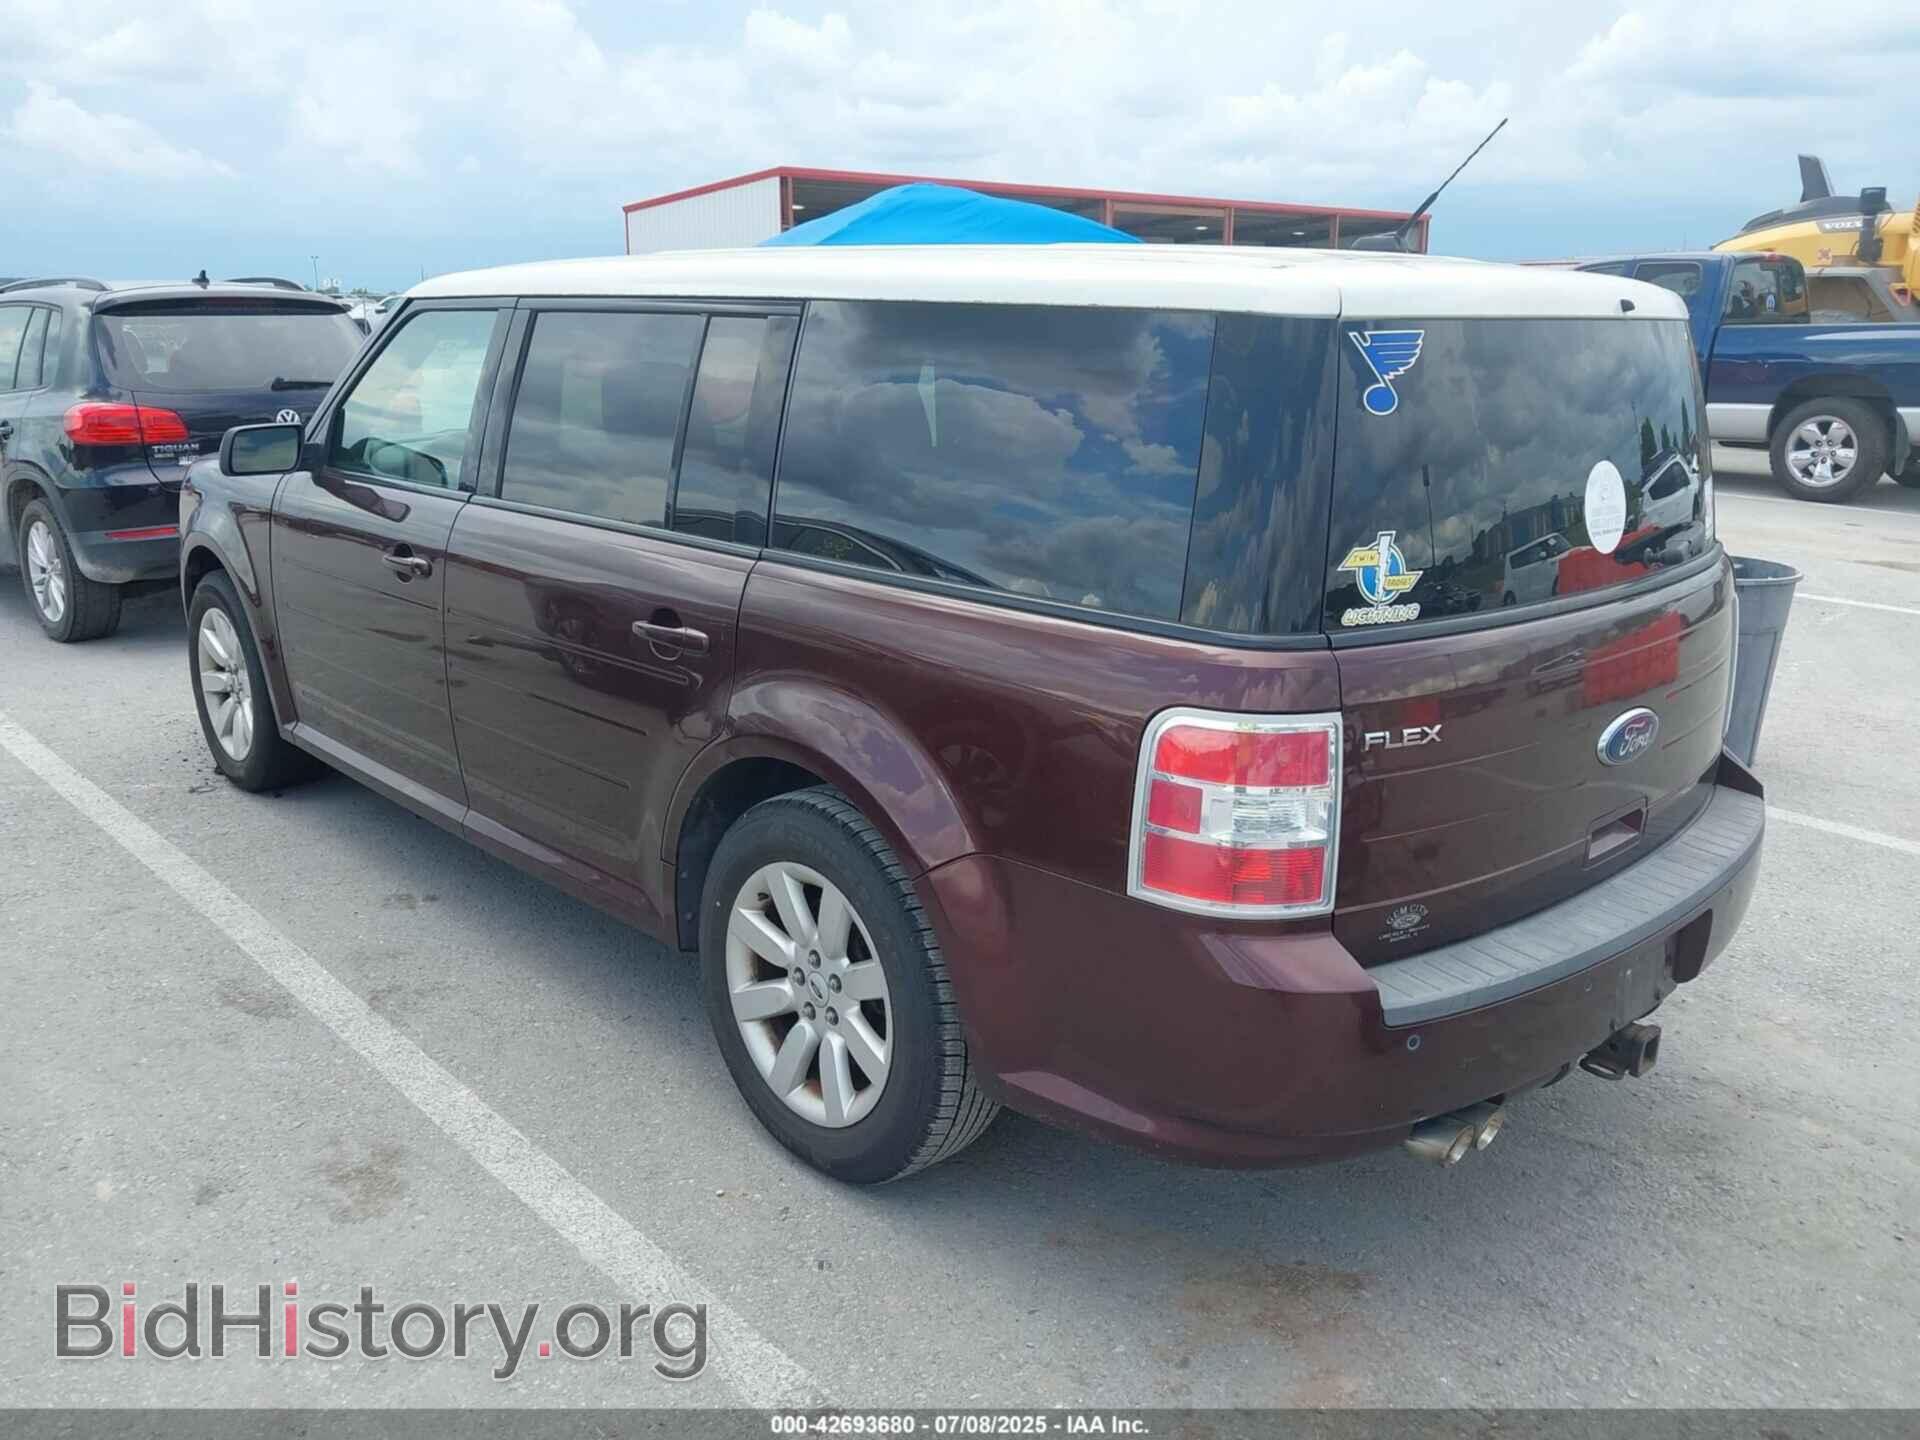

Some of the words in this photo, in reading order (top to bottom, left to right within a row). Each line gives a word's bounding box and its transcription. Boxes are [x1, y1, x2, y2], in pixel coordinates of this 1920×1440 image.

[152, 443, 200, 454] TIGUAN
[1342, 603, 1420, 626] LIGHTNING
[1363, 724, 1443, 751] FLEX
